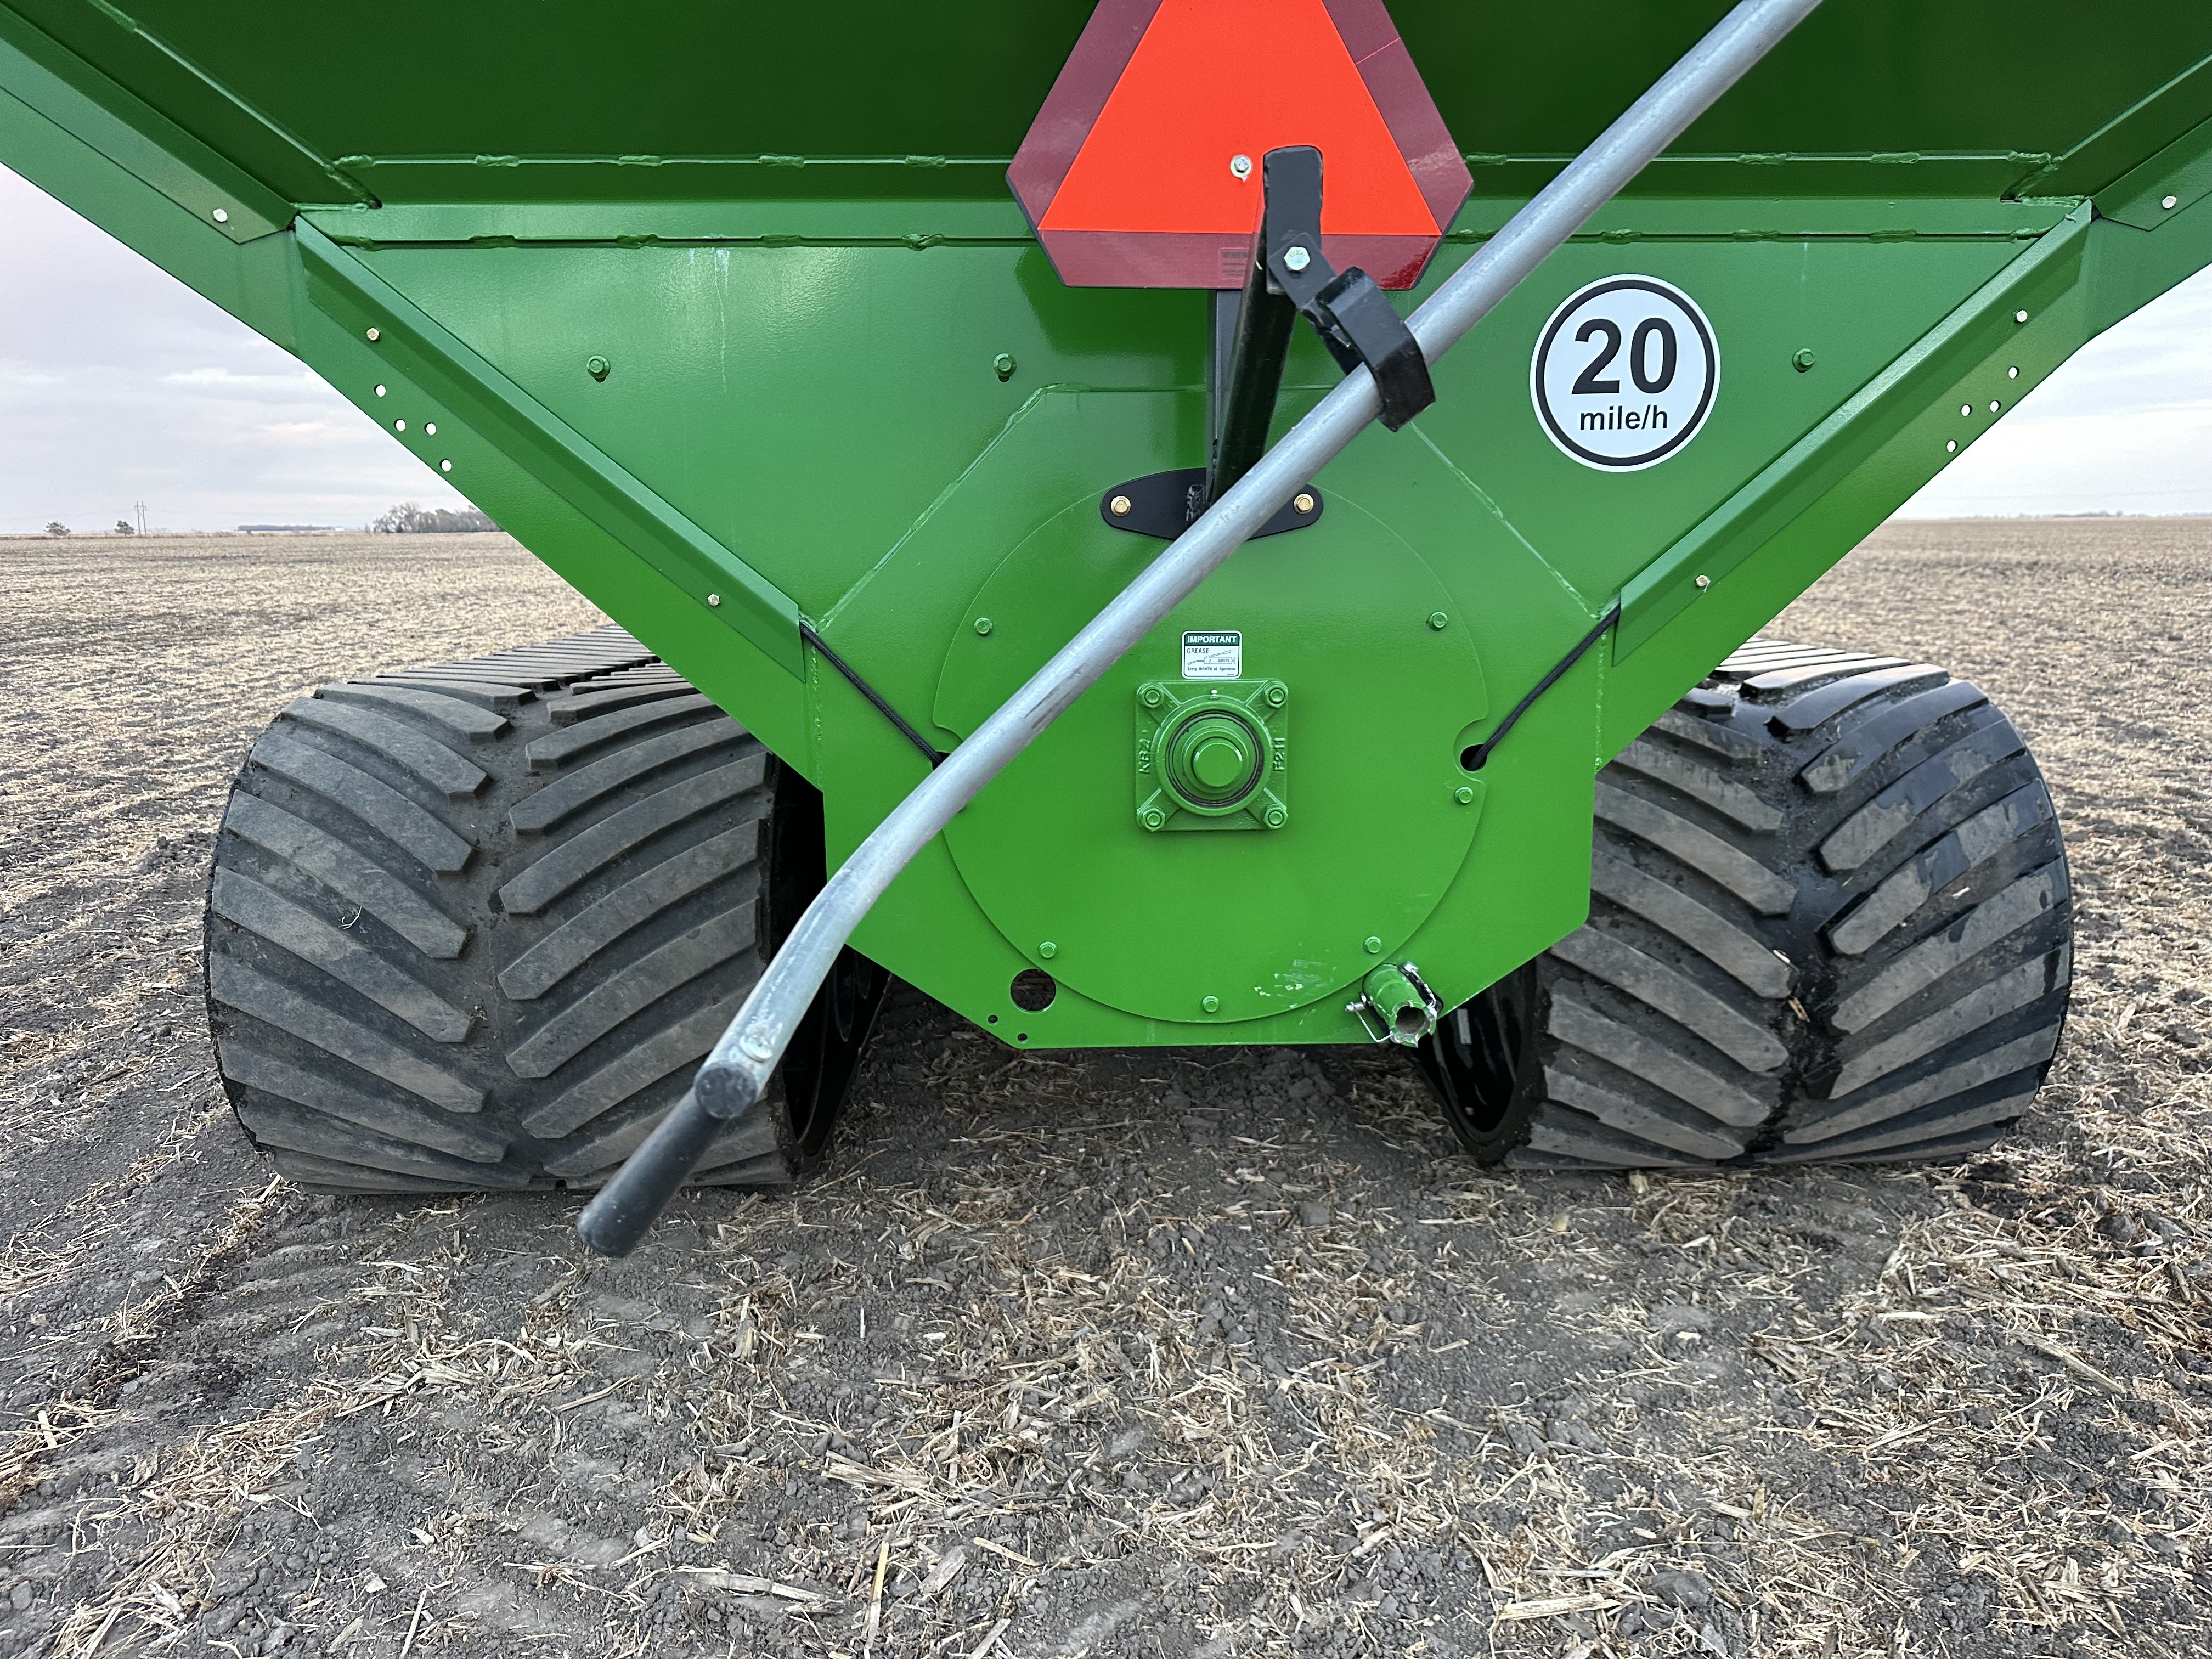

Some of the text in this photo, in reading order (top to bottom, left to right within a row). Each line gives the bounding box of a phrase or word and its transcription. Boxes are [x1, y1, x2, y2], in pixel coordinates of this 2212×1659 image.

[1572, 317, 1677, 394] 20
[1579, 404, 1668, 430] mile/h
[1187, 635, 1237, 644] IMPORTANT
